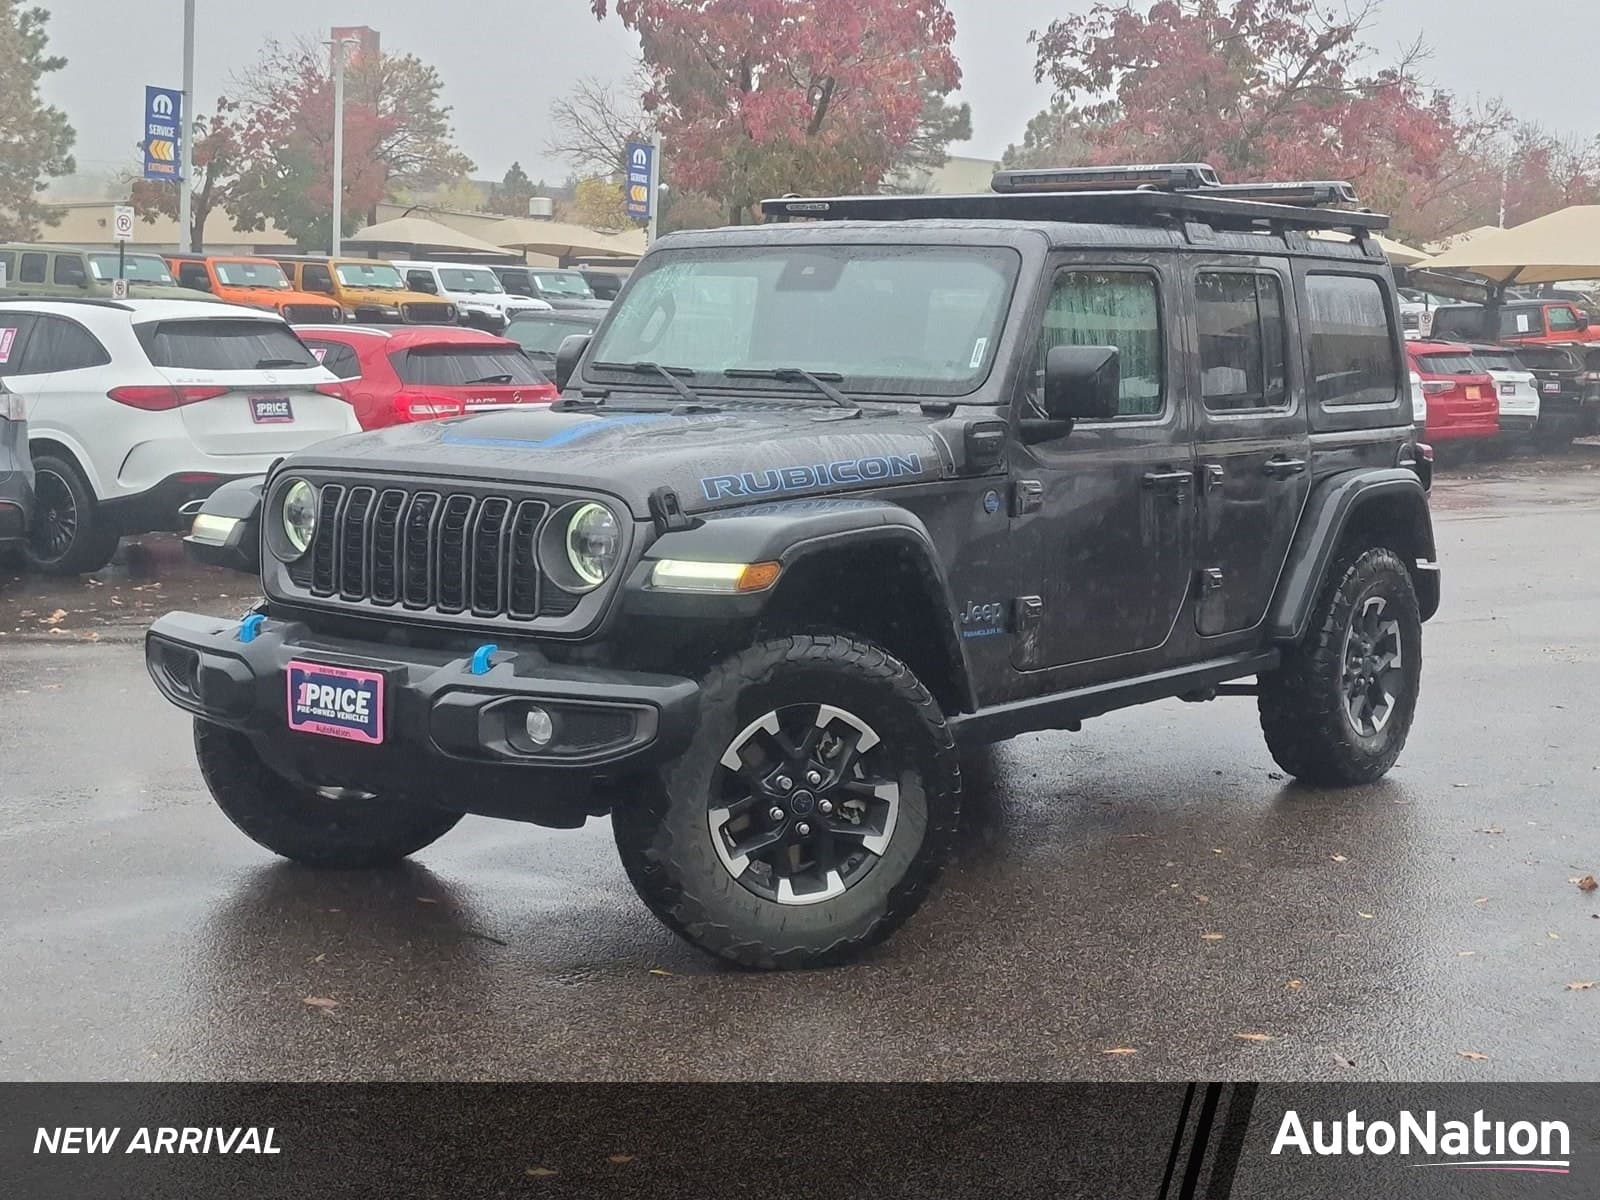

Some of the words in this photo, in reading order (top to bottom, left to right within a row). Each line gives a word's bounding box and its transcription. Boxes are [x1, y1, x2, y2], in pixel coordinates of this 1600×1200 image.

[149, 124, 175, 137] SERVICE
[701, 453, 922, 500] RUBICON
[959, 600, 1001, 624] Jeep
[297, 705, 335, 717] PRE-OWNED
[337, 711, 369, 723] VEHICLES
